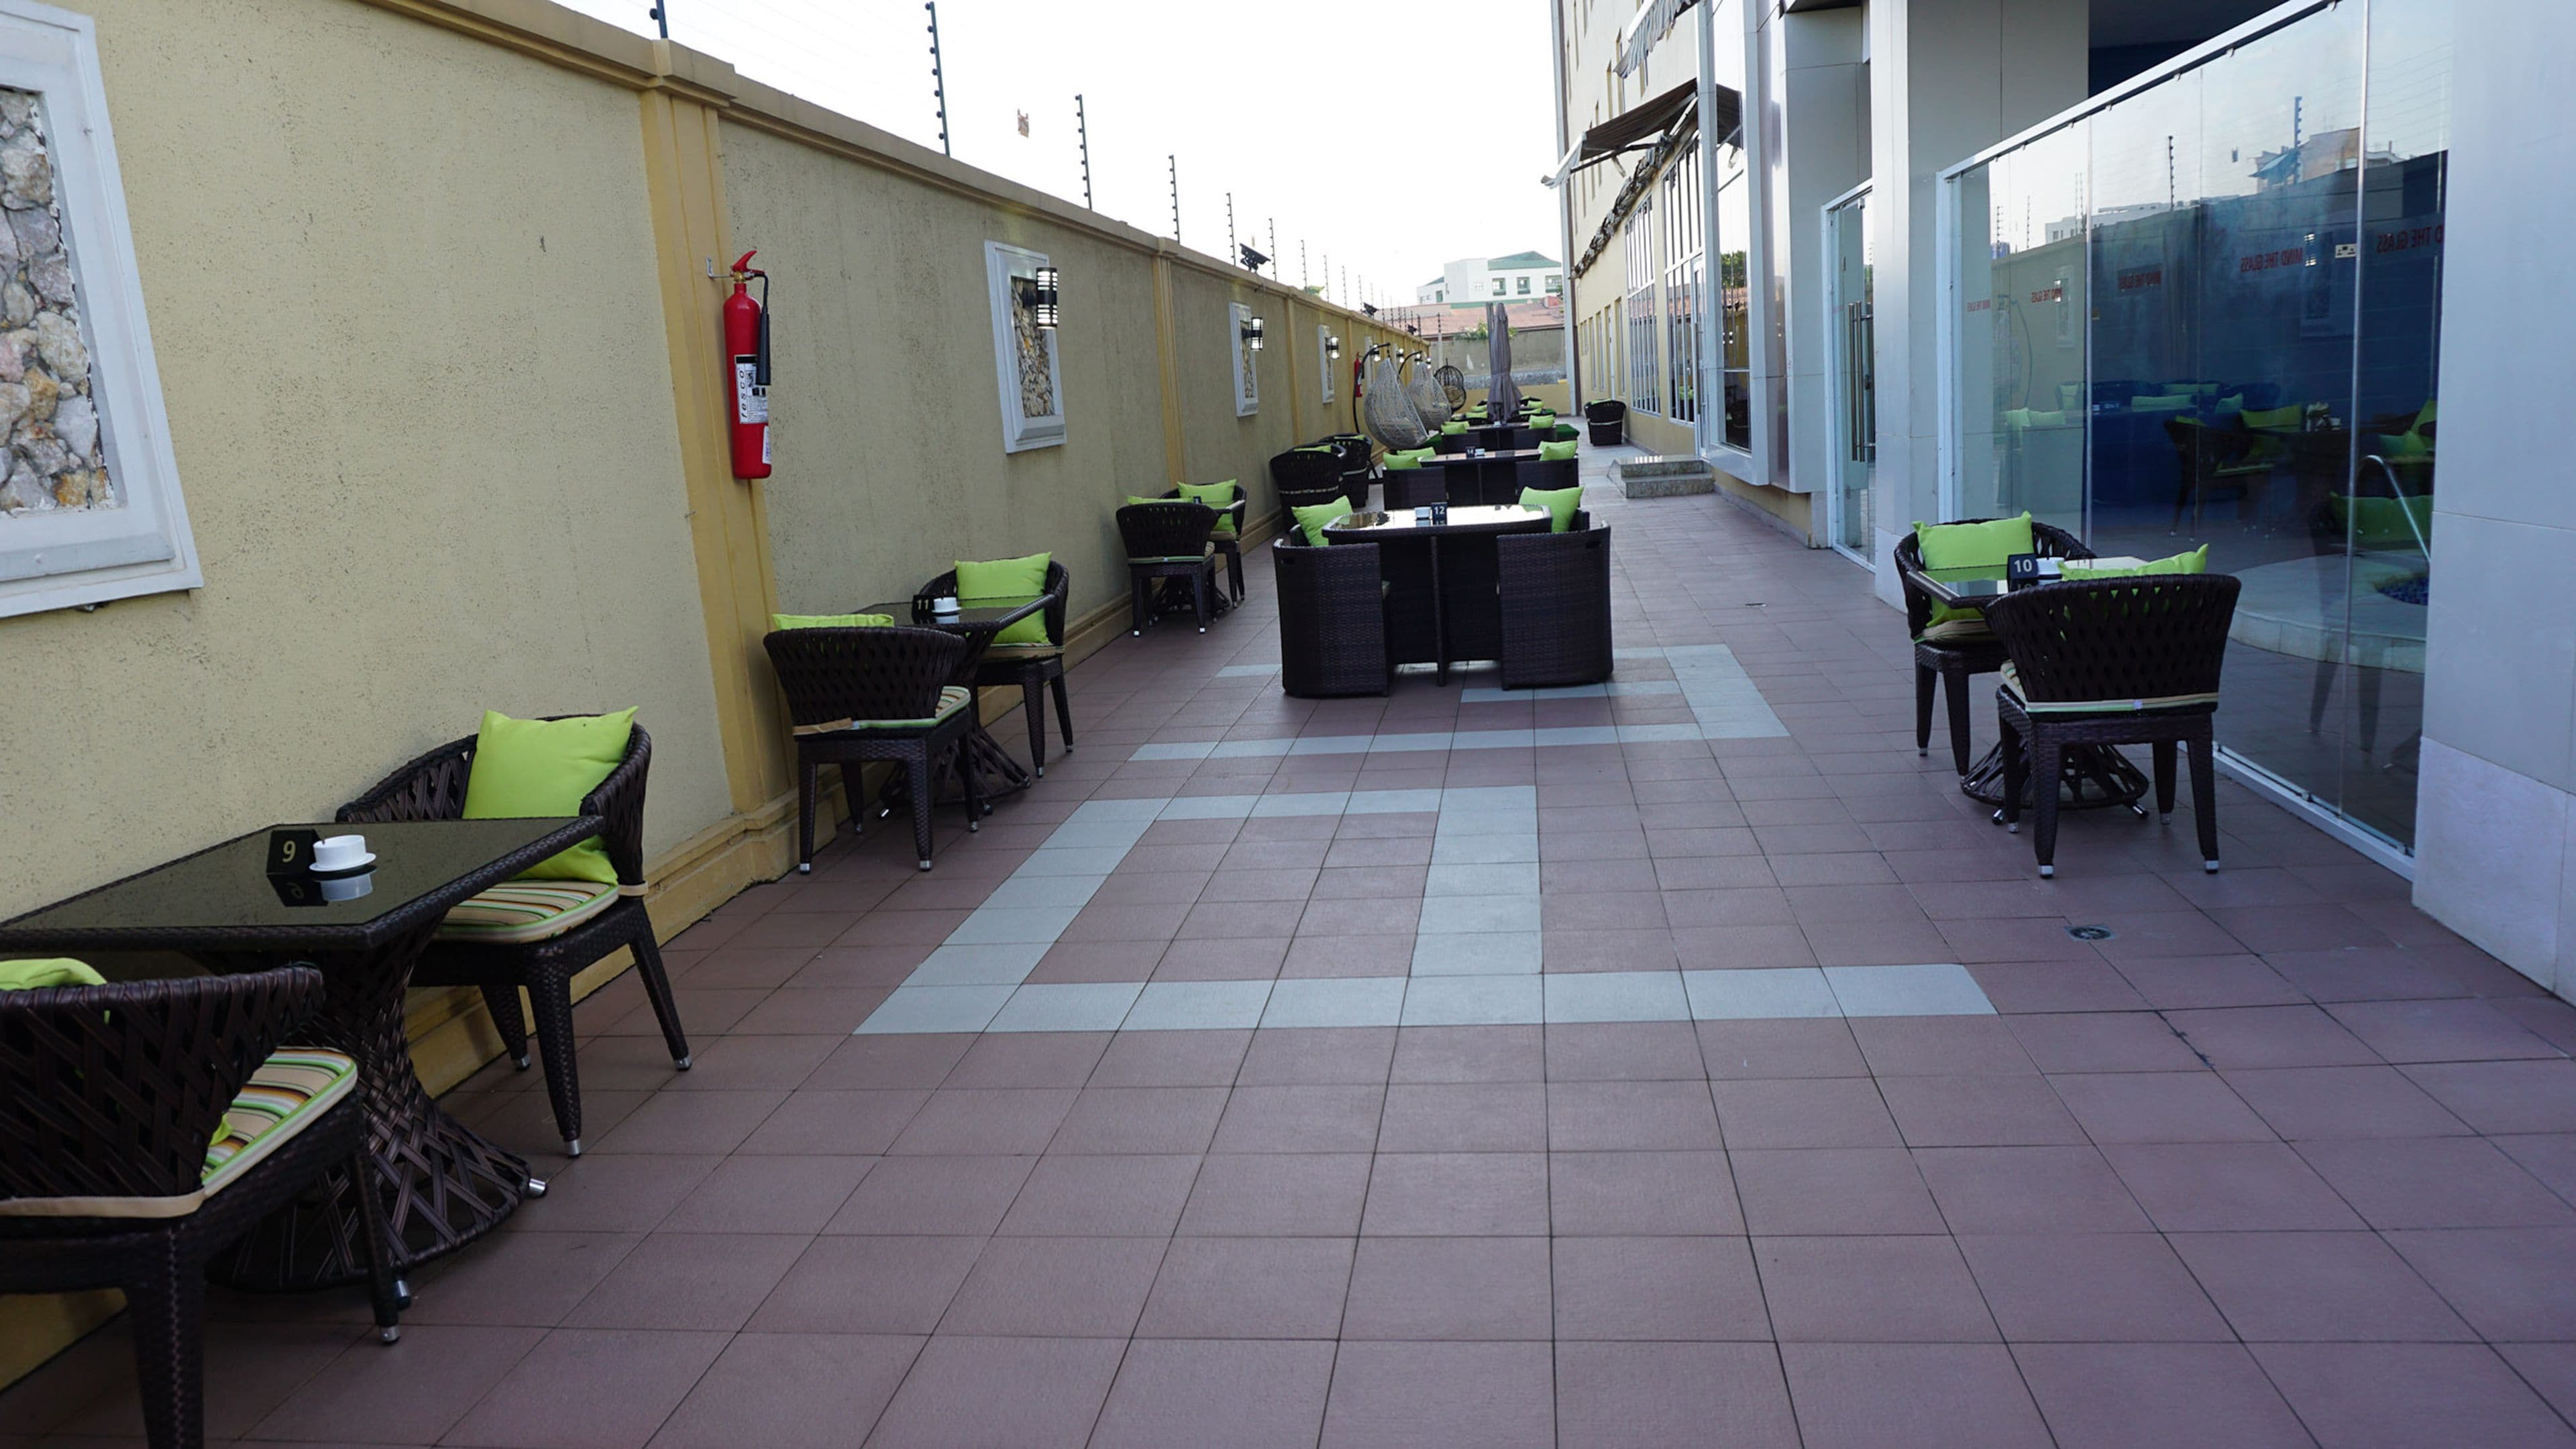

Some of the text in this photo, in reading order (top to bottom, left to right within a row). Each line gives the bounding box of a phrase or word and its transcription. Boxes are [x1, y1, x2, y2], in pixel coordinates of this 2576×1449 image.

[1434, 506, 1445, 515] 12
[2014, 559, 2033, 573] 10
[917, 599, 929, 610] 11
[282, 841, 297, 863] 9
